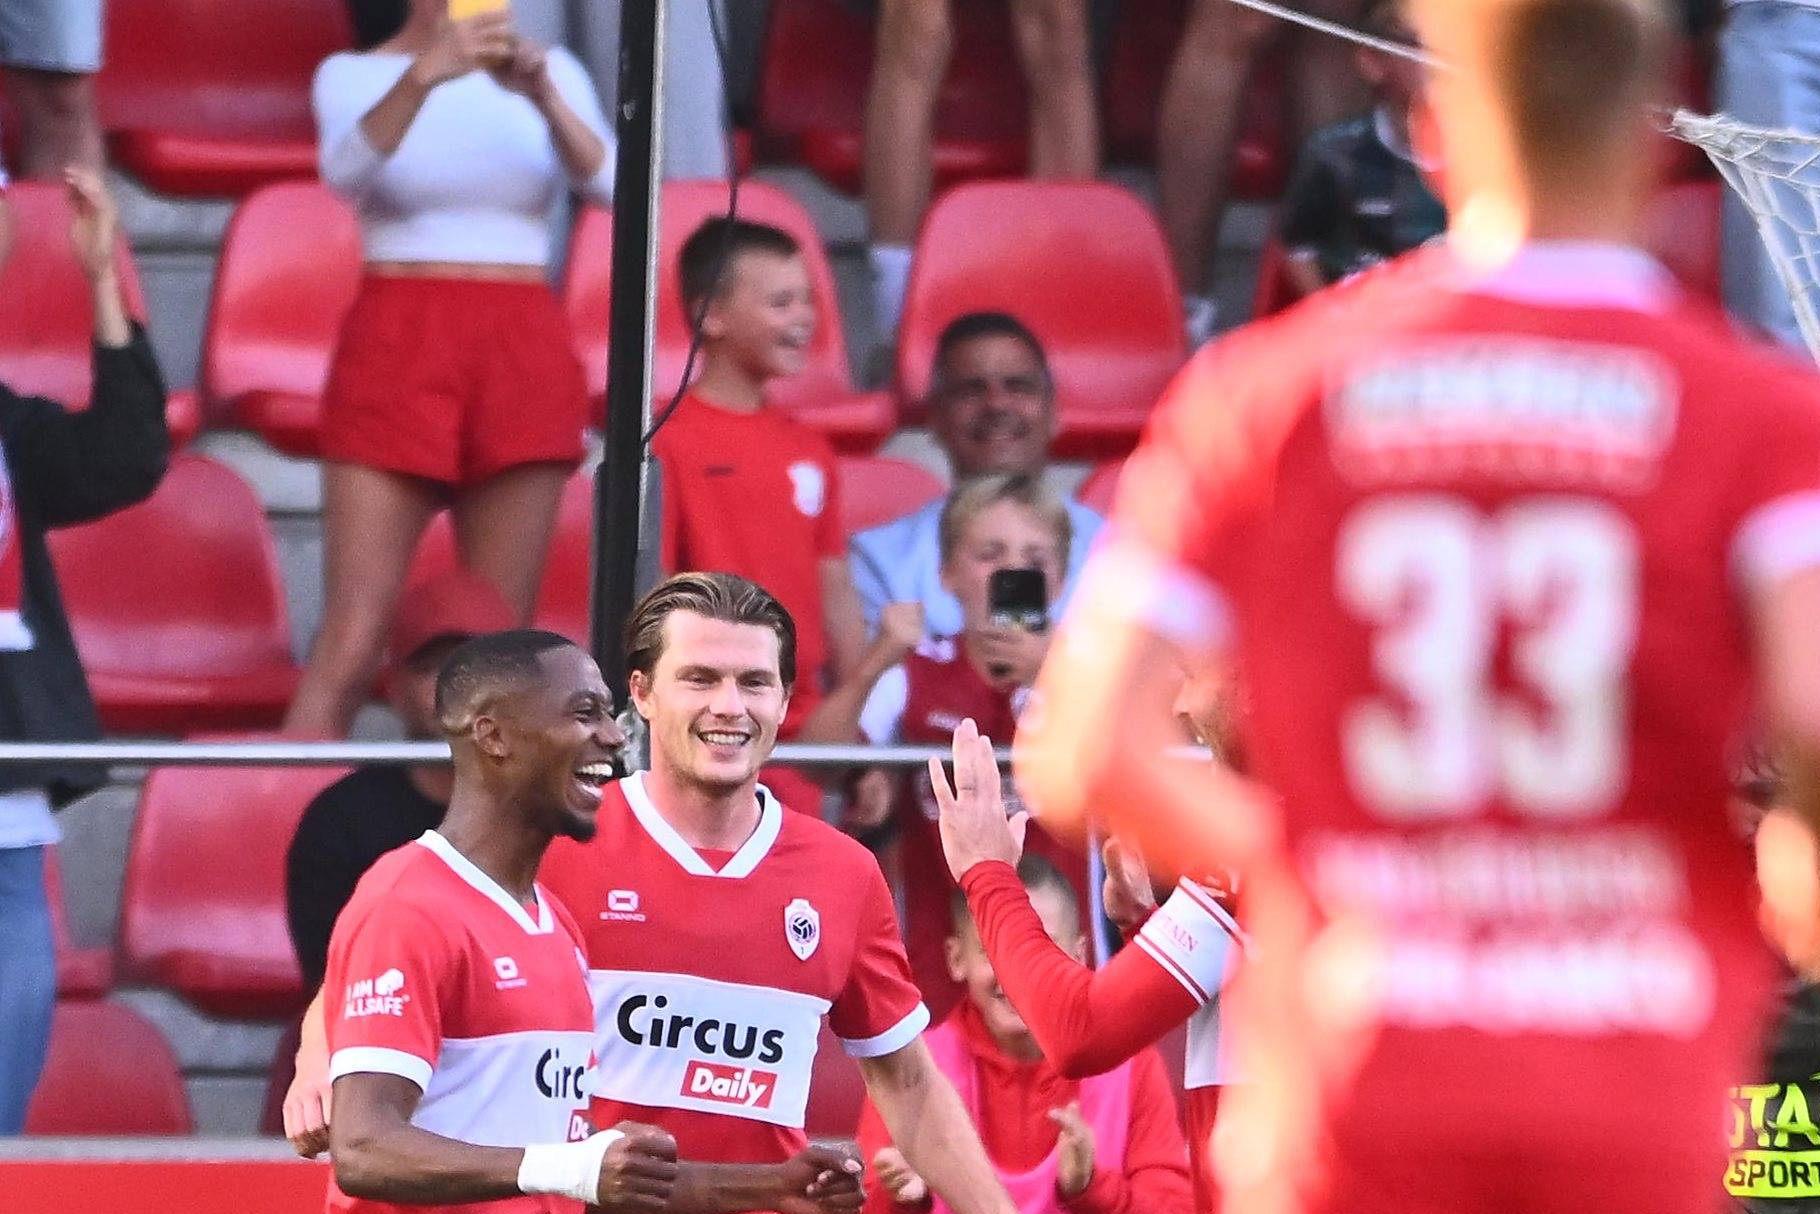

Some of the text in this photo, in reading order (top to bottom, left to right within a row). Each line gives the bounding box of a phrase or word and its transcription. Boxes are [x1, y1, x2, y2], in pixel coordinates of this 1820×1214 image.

[1335, 492, 1640, 822] 33
[617, 994, 785, 1064] Circus
[690, 1067, 768, 1108] Daily
